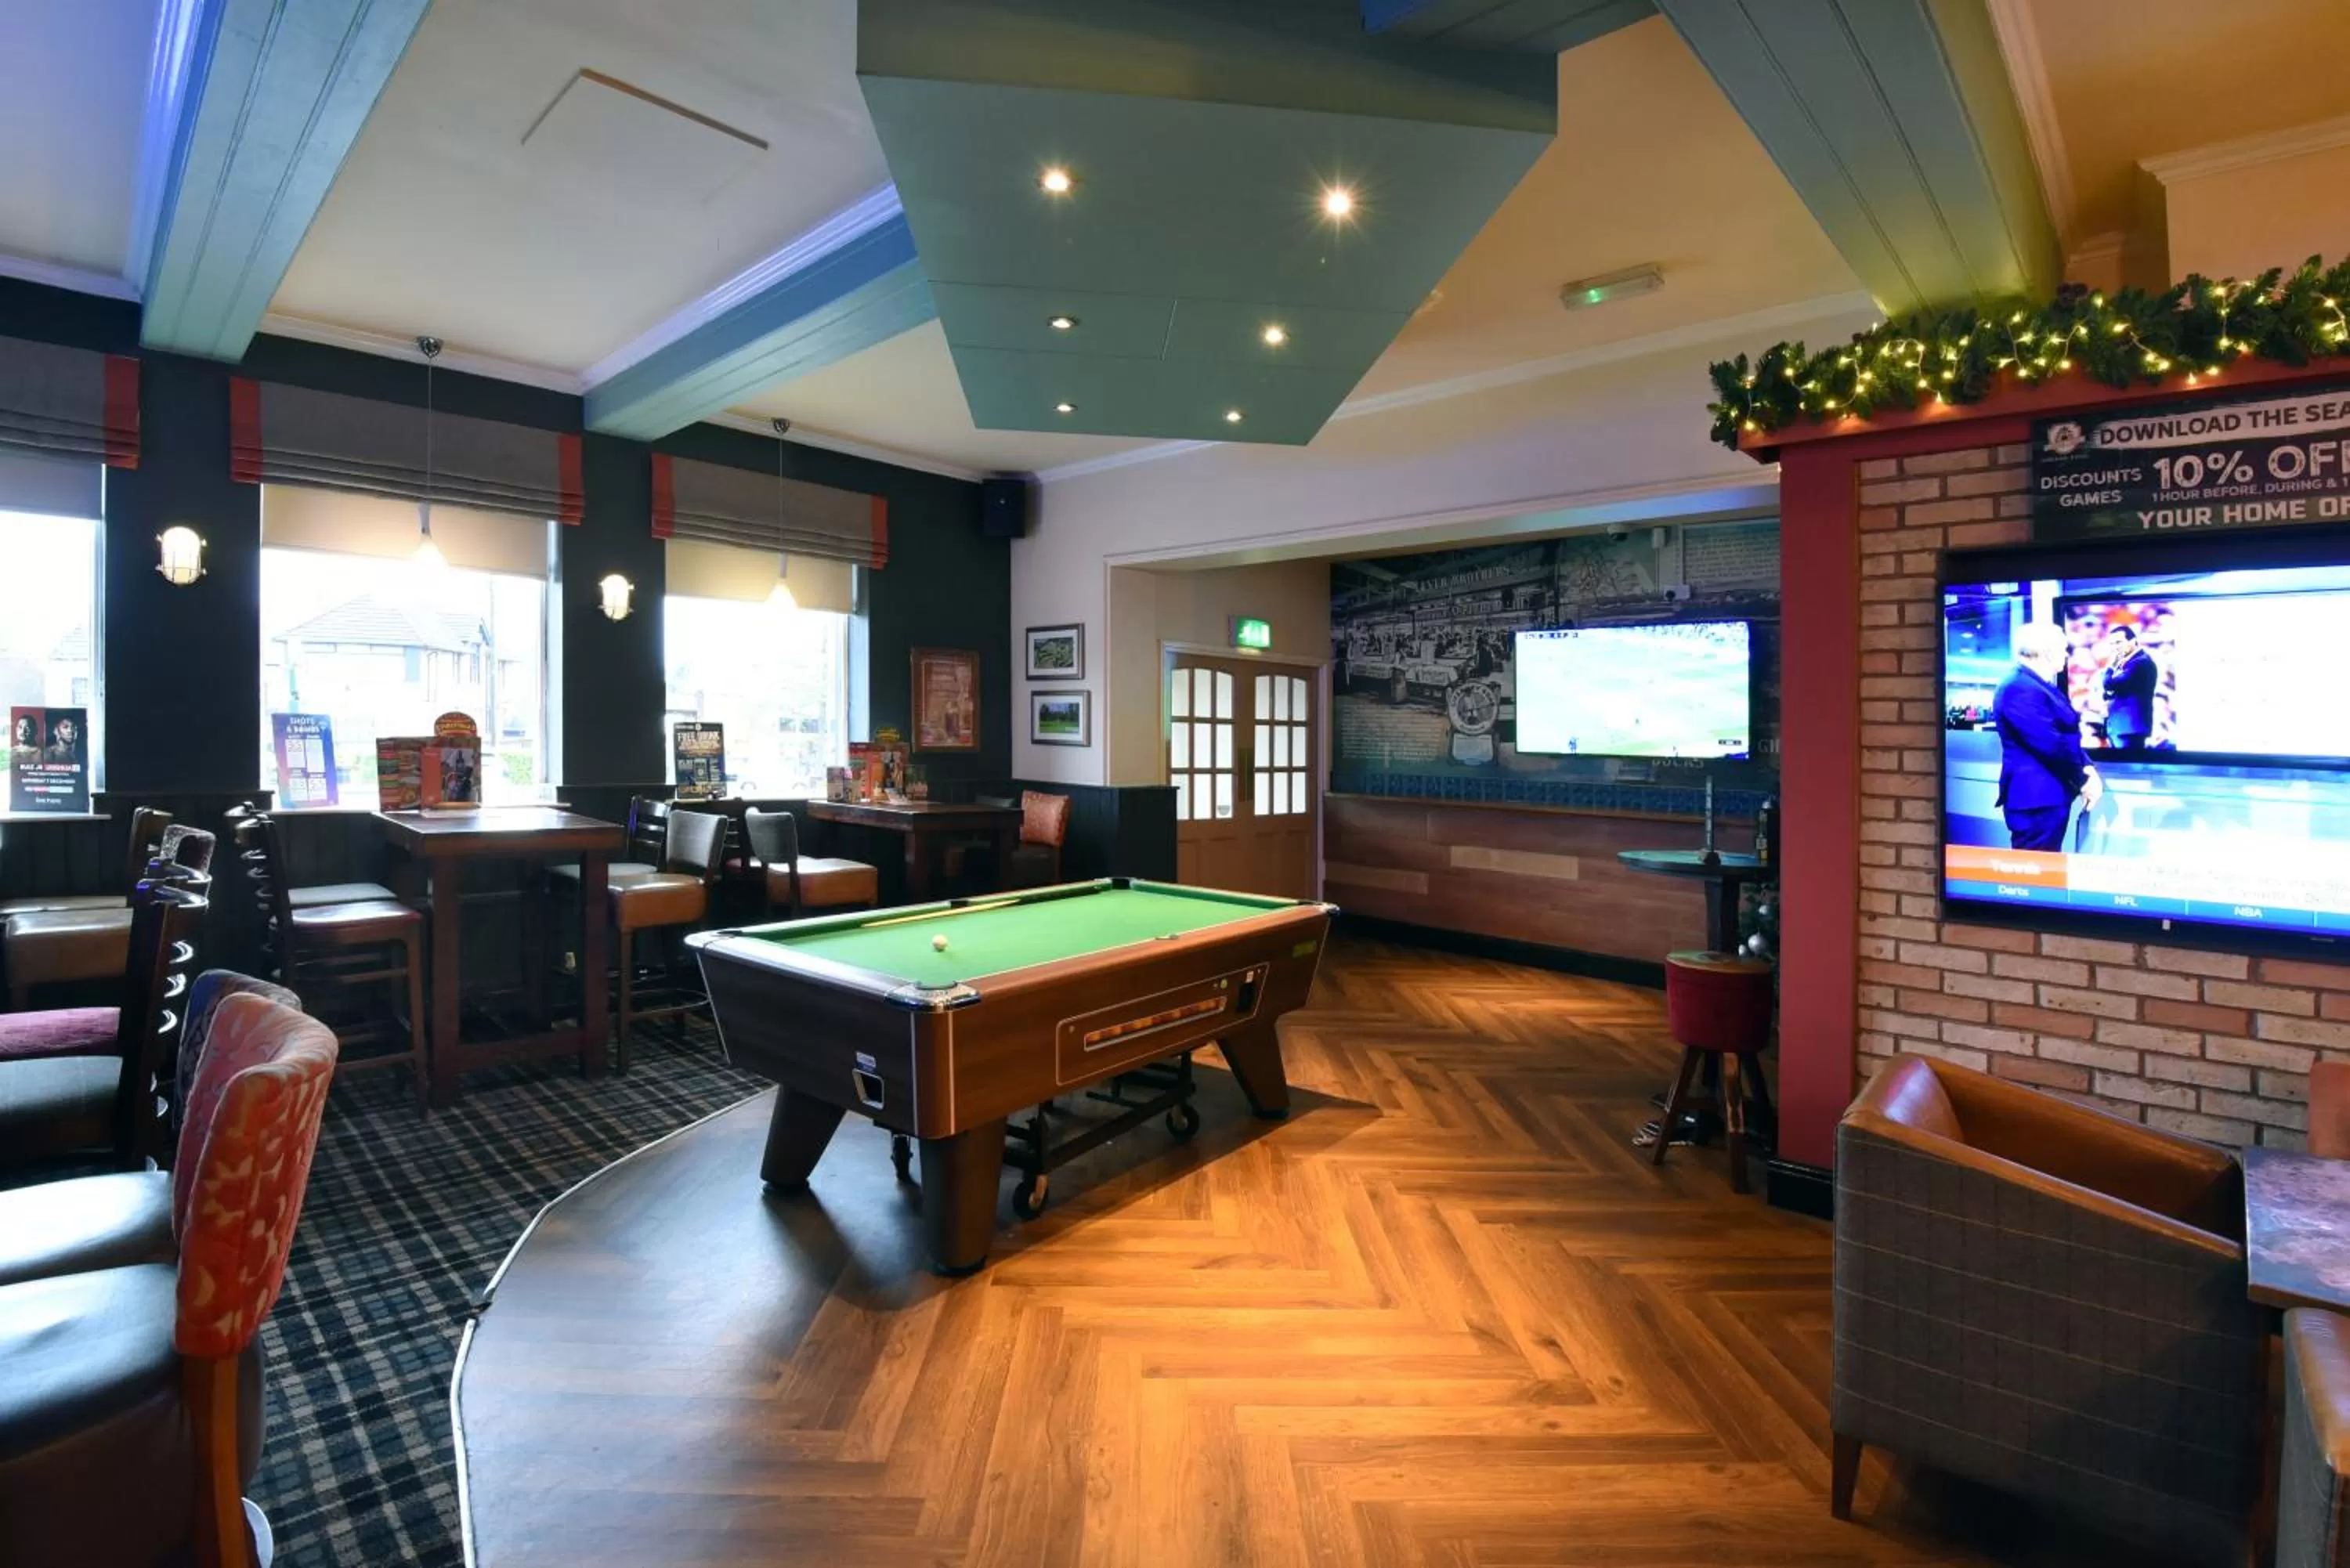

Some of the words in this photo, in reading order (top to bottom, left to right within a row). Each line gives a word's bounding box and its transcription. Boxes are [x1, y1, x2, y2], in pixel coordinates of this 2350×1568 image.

[2100, 414, 2241, 445] DOWNLOAD
[2247, 406, 2298, 428] THE
[2040, 468, 2143, 490] DISCOUNTS
[2153, 450, 2254, 490] 10%
[2059, 490, 2123, 508] GAMES
[2160, 488, 2200, 502] HOUR
[2265, 479, 2323, 493] DURING
[2326, 477, 2337, 488] &
[2137, 507, 2212, 529] YOUR
[2222, 499, 2307, 524] HOME
[2113, 895, 2139, 908] NFL
[2233, 905, 2264, 919] NBA
